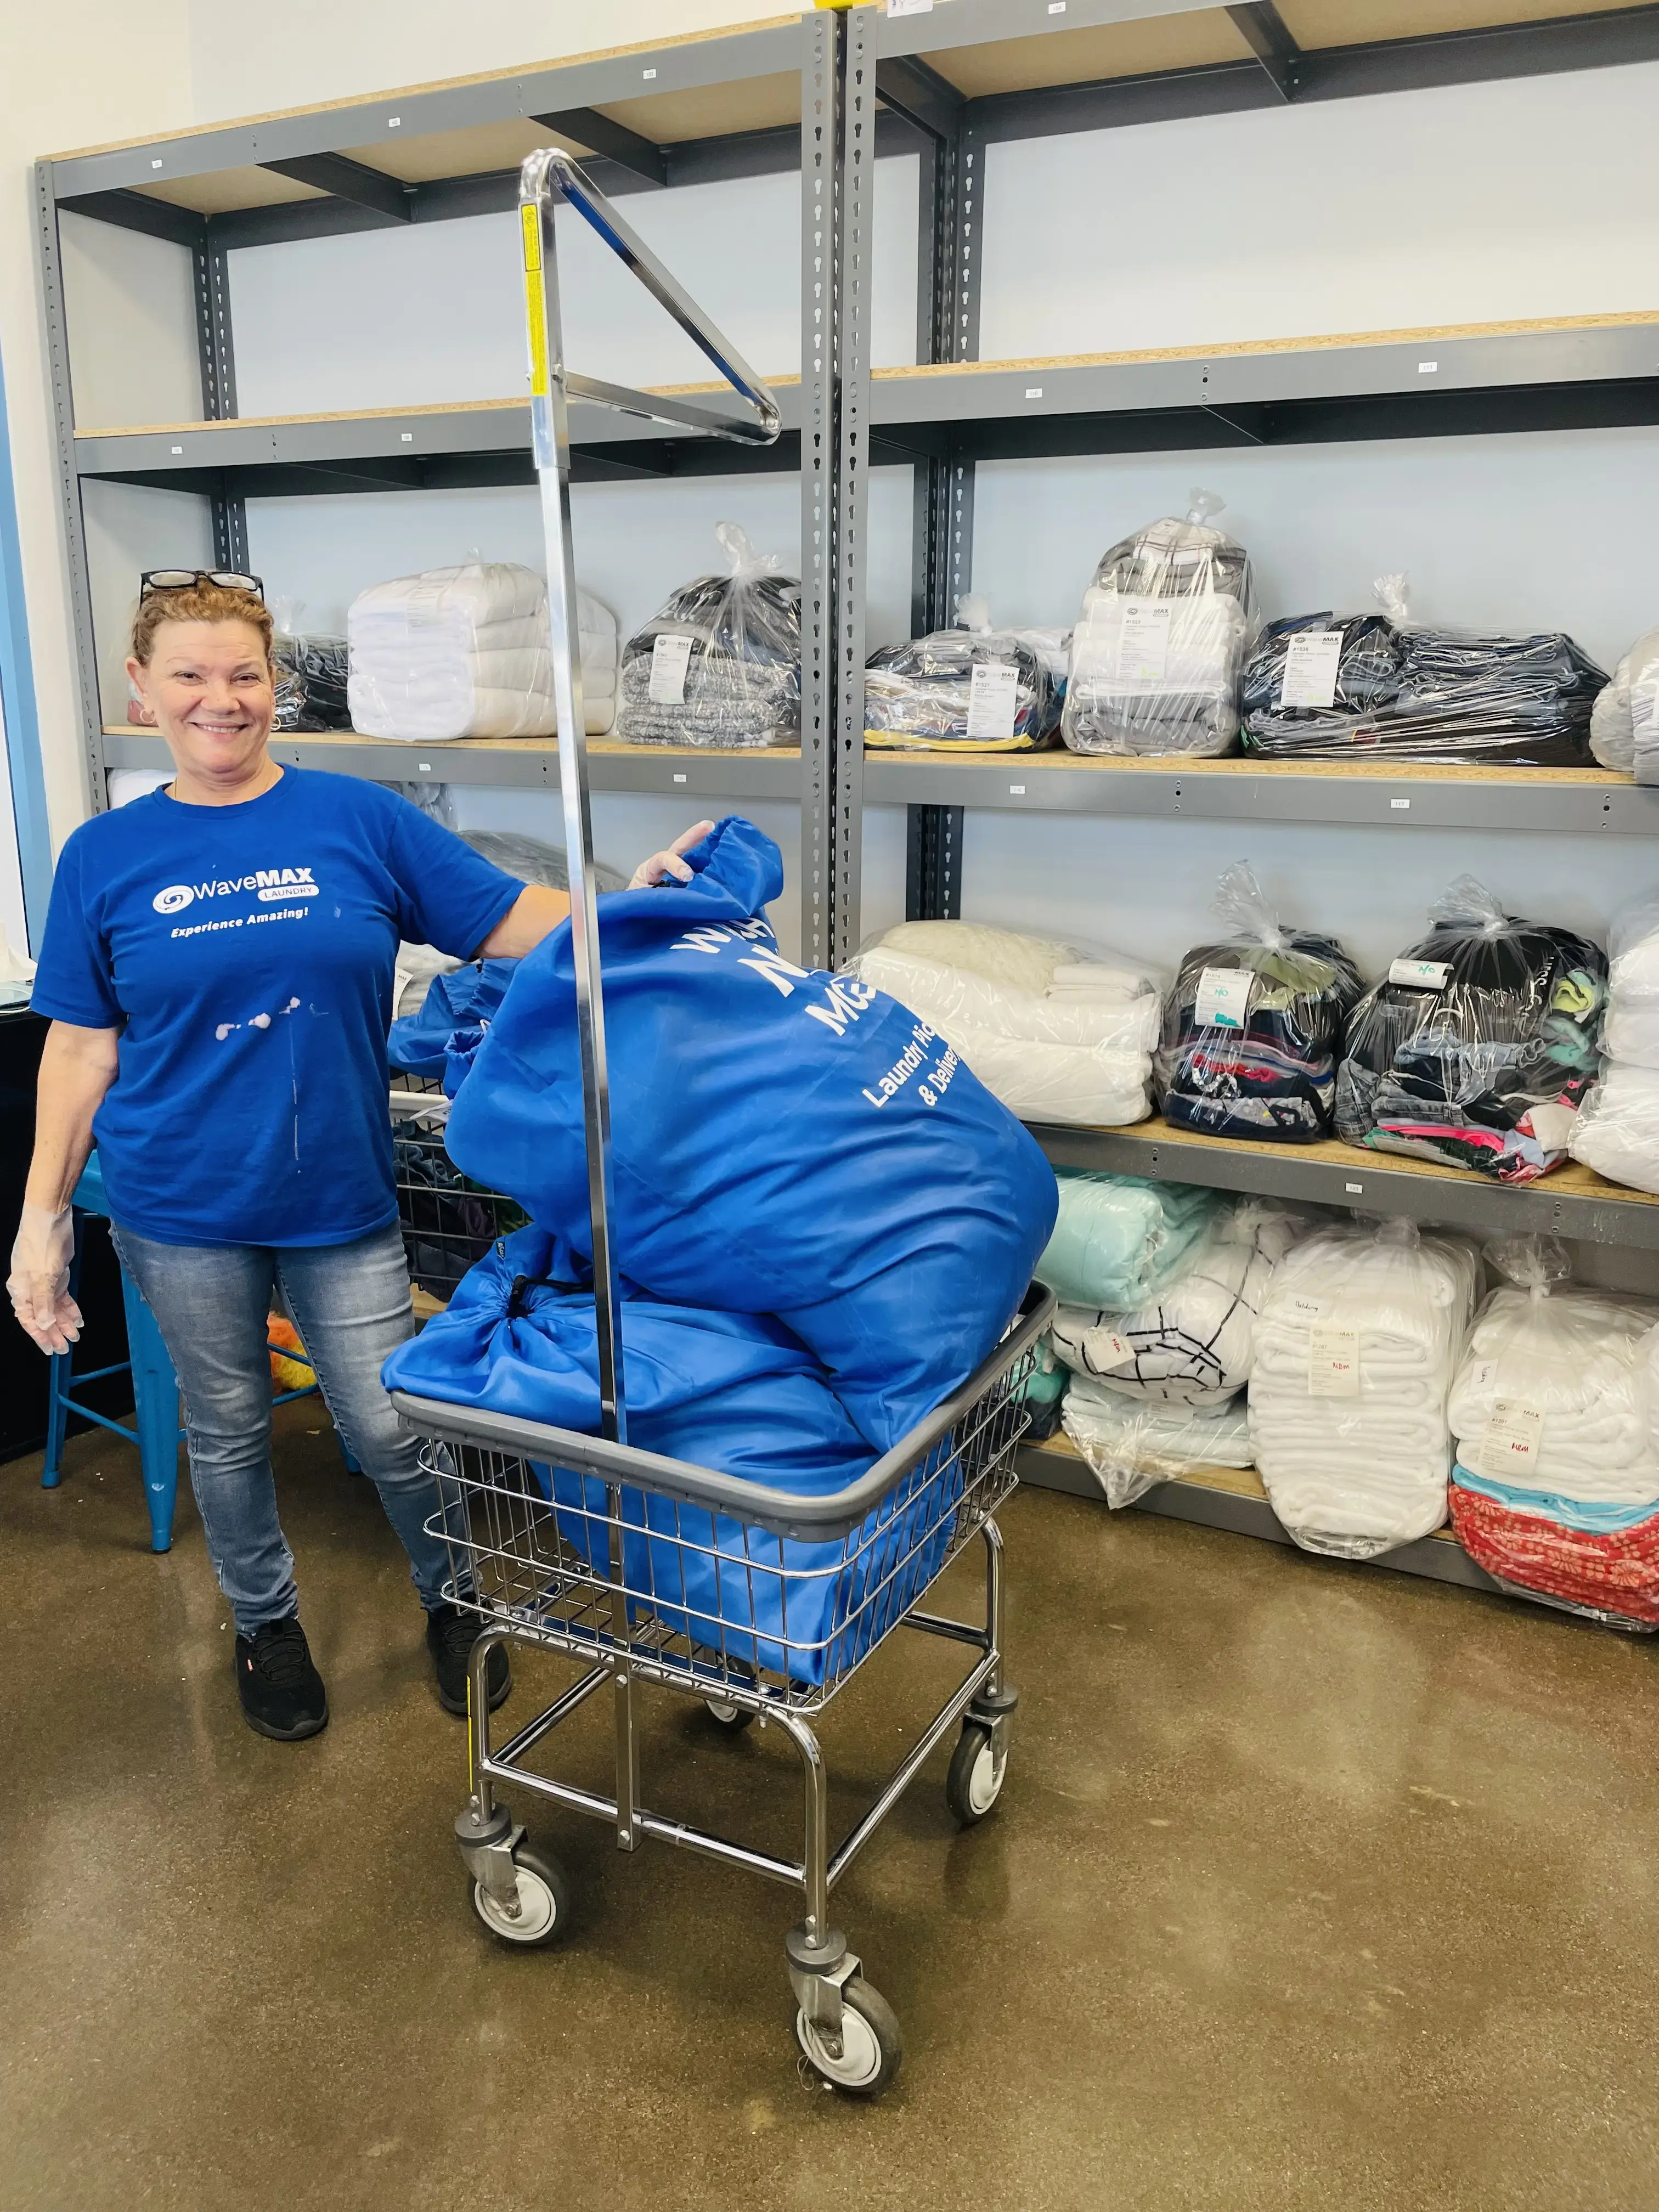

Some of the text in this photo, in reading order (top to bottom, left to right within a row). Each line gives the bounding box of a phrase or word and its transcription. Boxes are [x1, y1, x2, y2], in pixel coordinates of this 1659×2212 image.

[193, 868, 315, 900] WaveMAX
[264, 887, 313, 899] LAUNDRY
[171, 906, 309, 939] Experience Amazing!
[862, 1040, 929, 1108] Laundry
[918, 1085, 938, 1107] &
